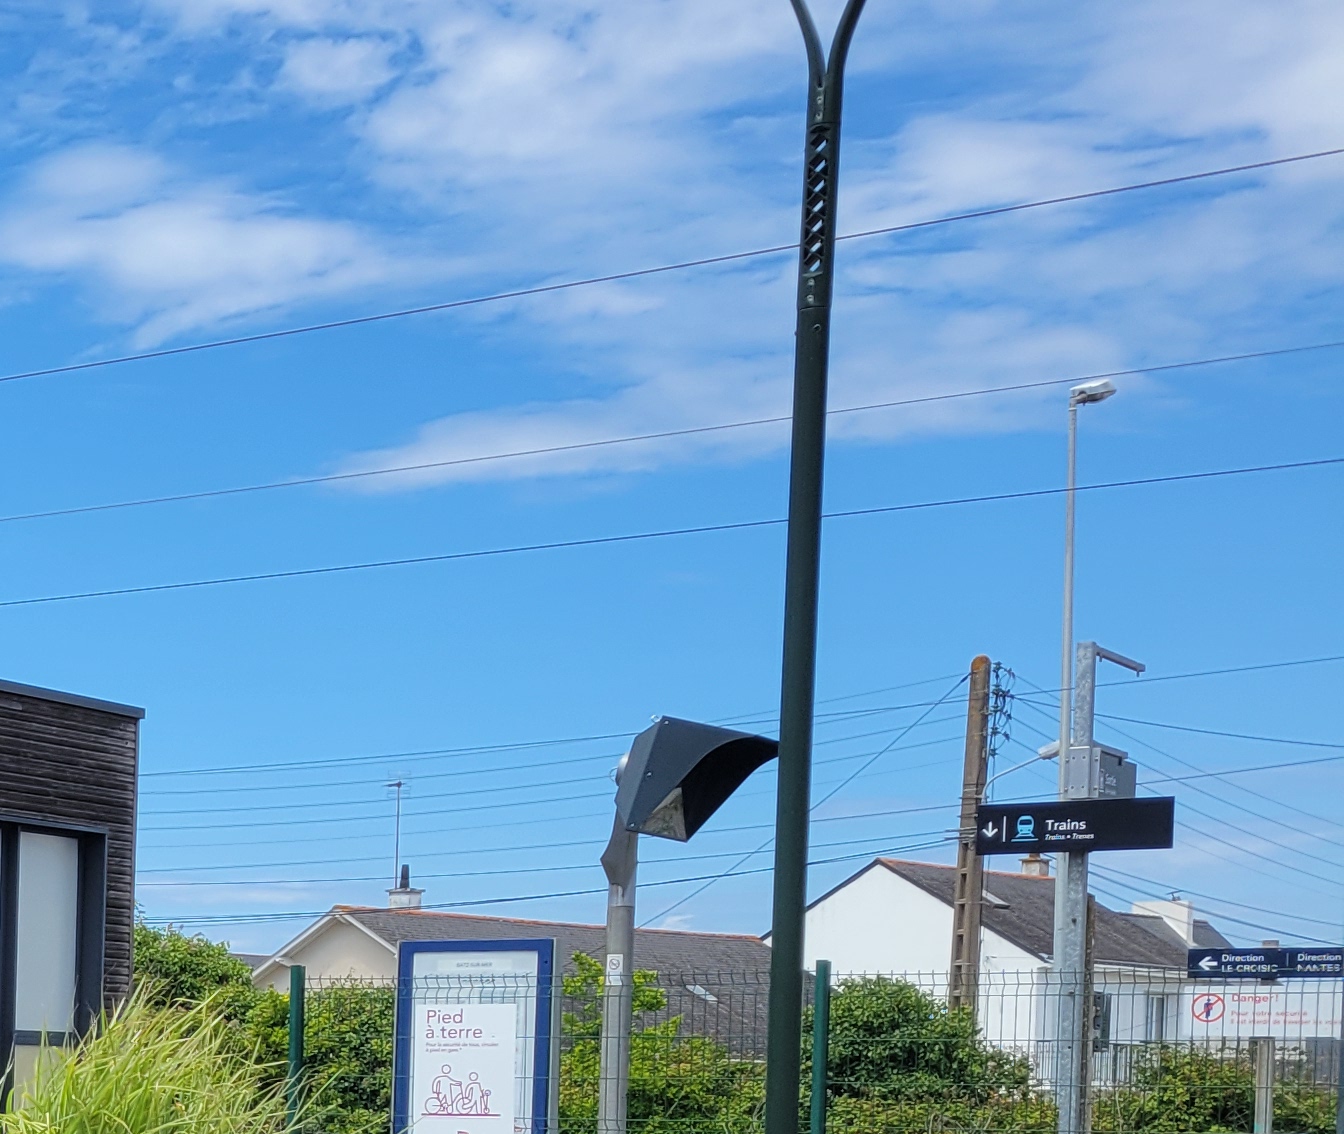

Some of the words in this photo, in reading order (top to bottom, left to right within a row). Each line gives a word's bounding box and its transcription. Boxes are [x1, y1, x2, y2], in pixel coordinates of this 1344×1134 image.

[1045, 819, 1086, 831] Trains
[1221, 953, 1265, 962] Direction
[1297, 952, 1342, 961] Direction
[1221, 964, 1233, 973] LE
[426, 1008, 463, 1024] Pied
[425, 1024, 434, 1039] à
[440, 1025, 483, 1039] terre
